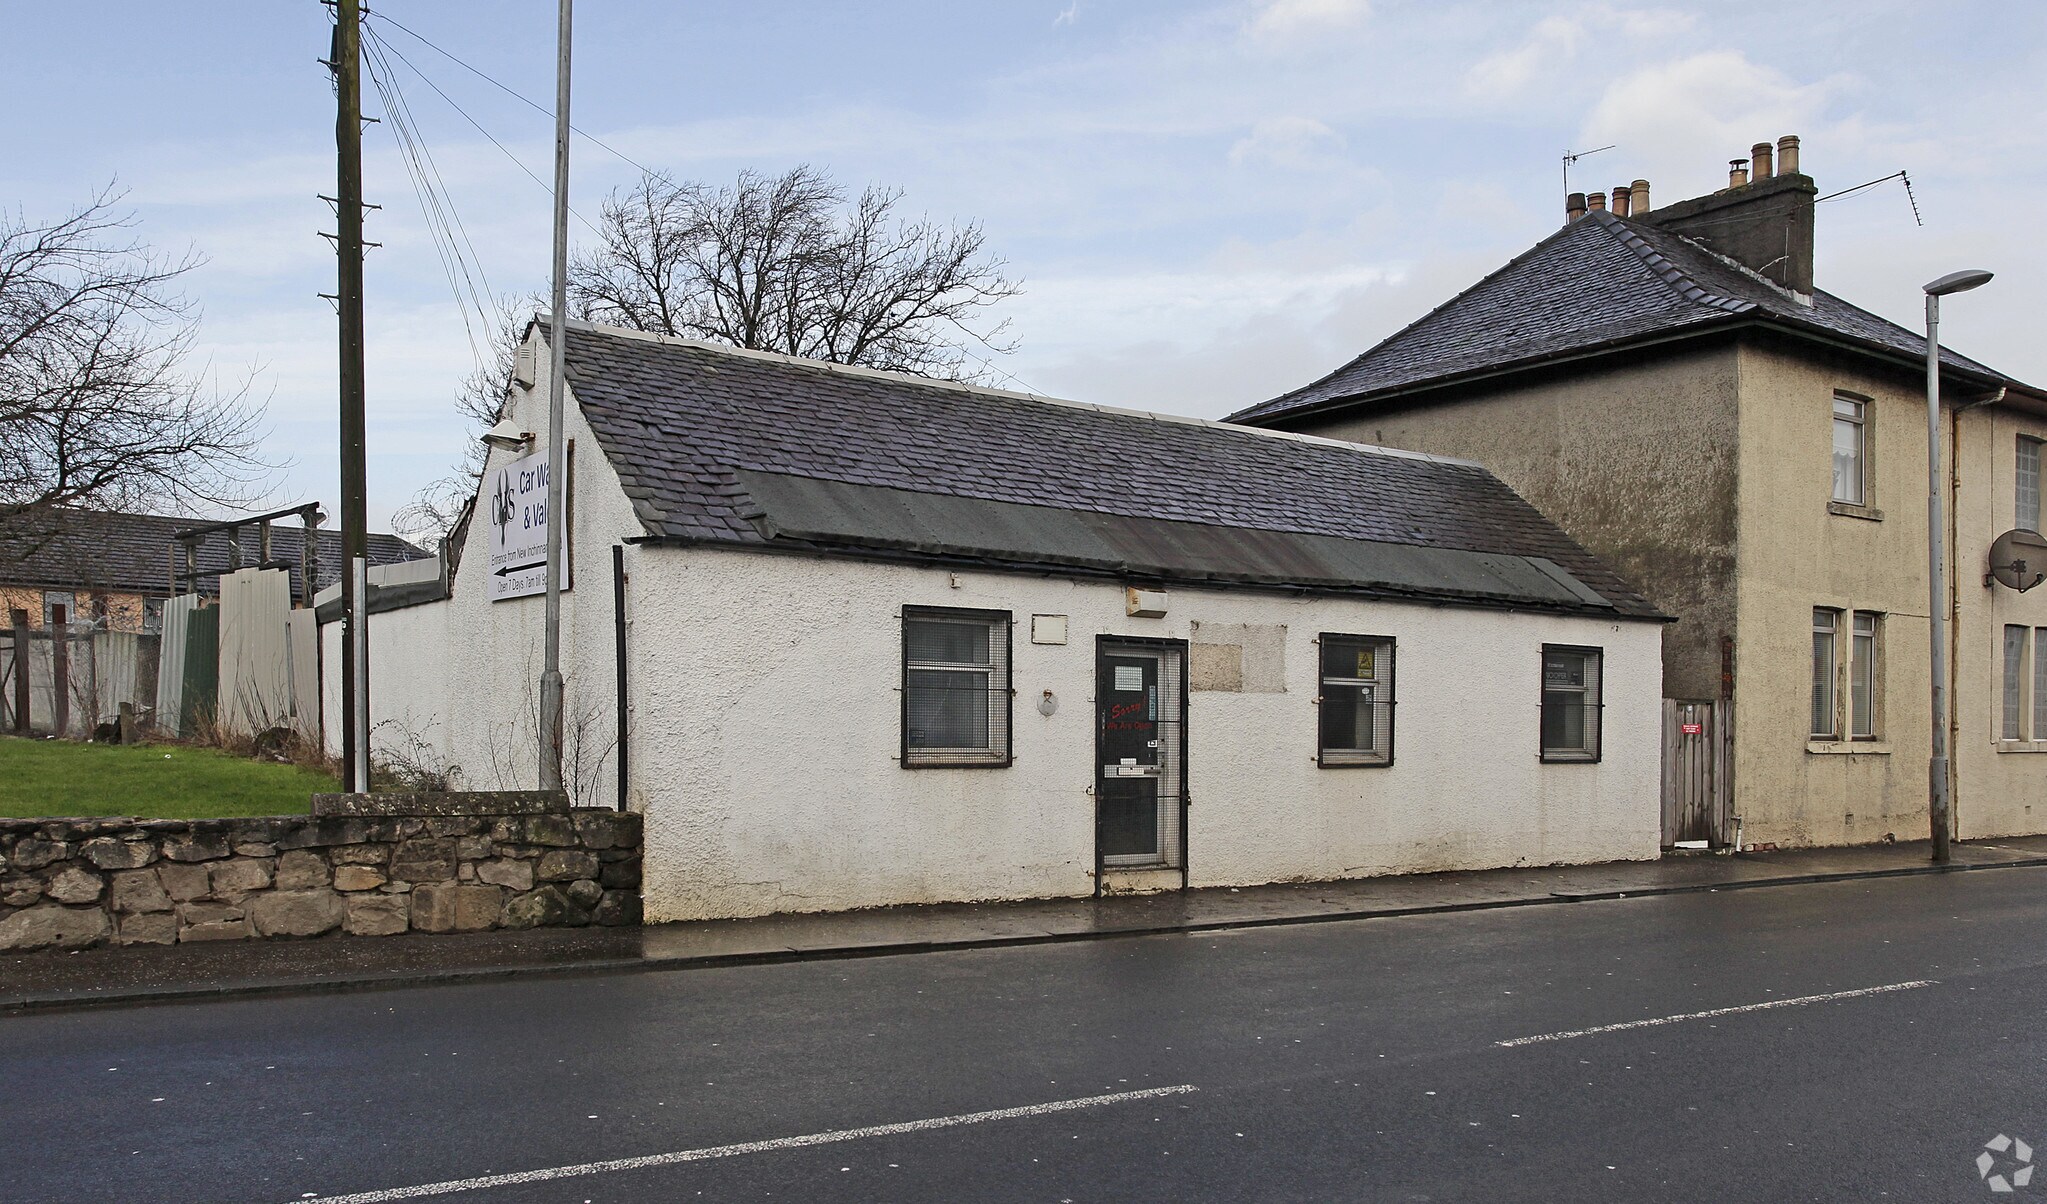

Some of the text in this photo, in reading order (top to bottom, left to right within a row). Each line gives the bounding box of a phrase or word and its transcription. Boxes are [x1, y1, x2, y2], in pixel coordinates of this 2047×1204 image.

[519, 462, 550, 494] Car Wa
[523, 498, 547, 530] & Val
[491, 543, 548, 566] Entrance from New Inchinna
[498, 581, 508, 594] Open
[525, 576, 535, 588] 7am
